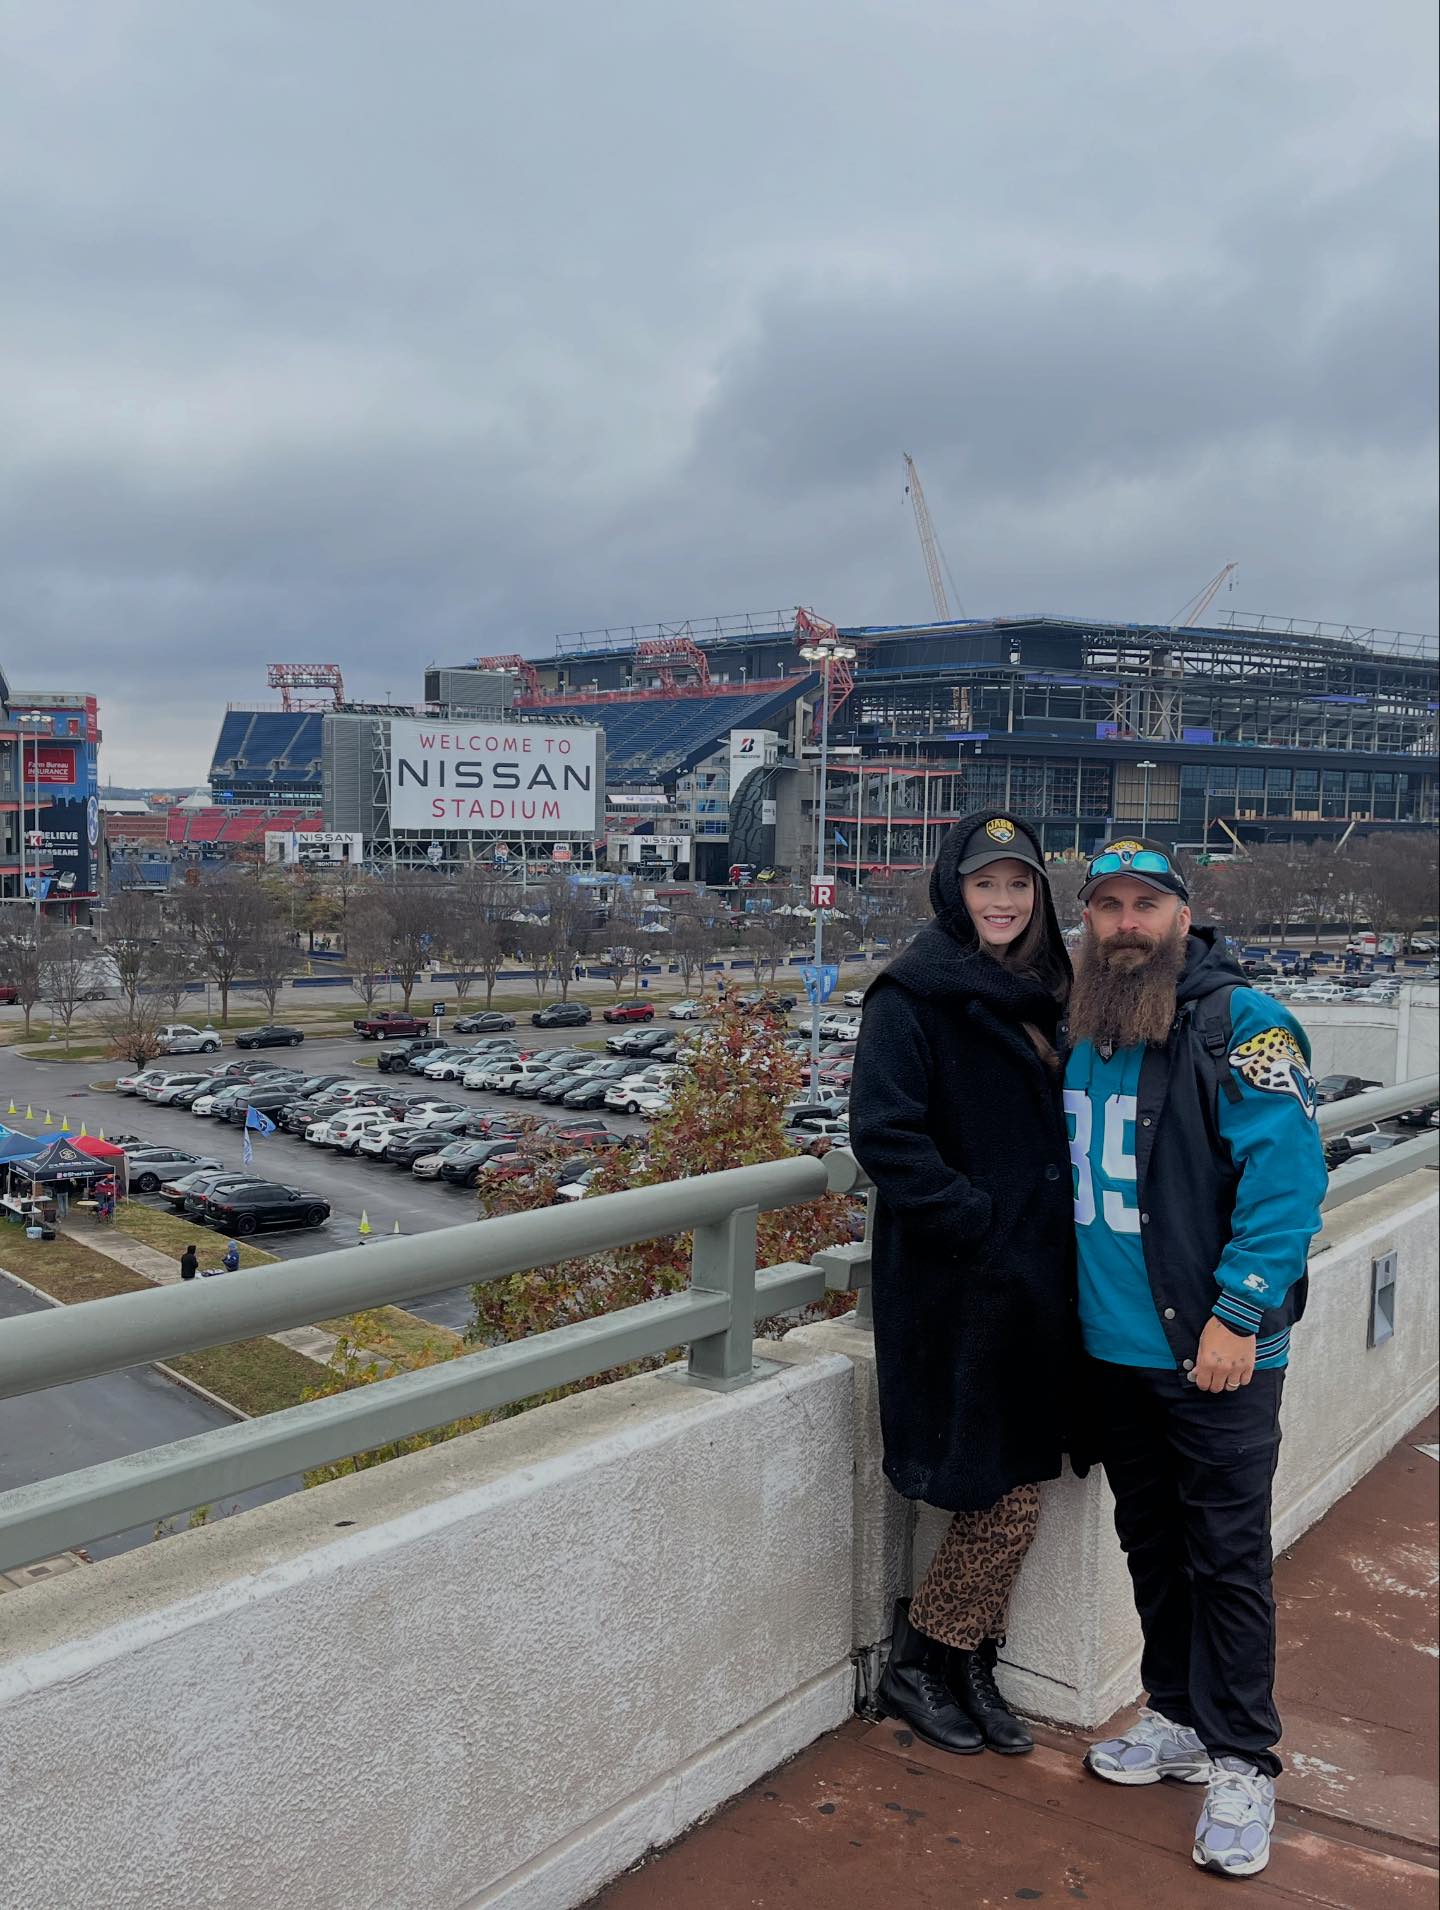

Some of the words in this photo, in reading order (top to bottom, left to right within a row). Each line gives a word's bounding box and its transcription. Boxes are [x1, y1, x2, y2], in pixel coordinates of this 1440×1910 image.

[419, 733, 532, 754] WELCOME
[544, 739, 571, 754] TO
[398, 758, 591, 791] NISSAN
[431, 798, 561, 820] STADIUM
[30, 836, 38, 847] K
[43, 832, 78, 840] ELIEVE
[299, 833, 354, 842] NISSAN
[641, 836, 684, 844] NISSAN
[818, 886, 831, 905] R
